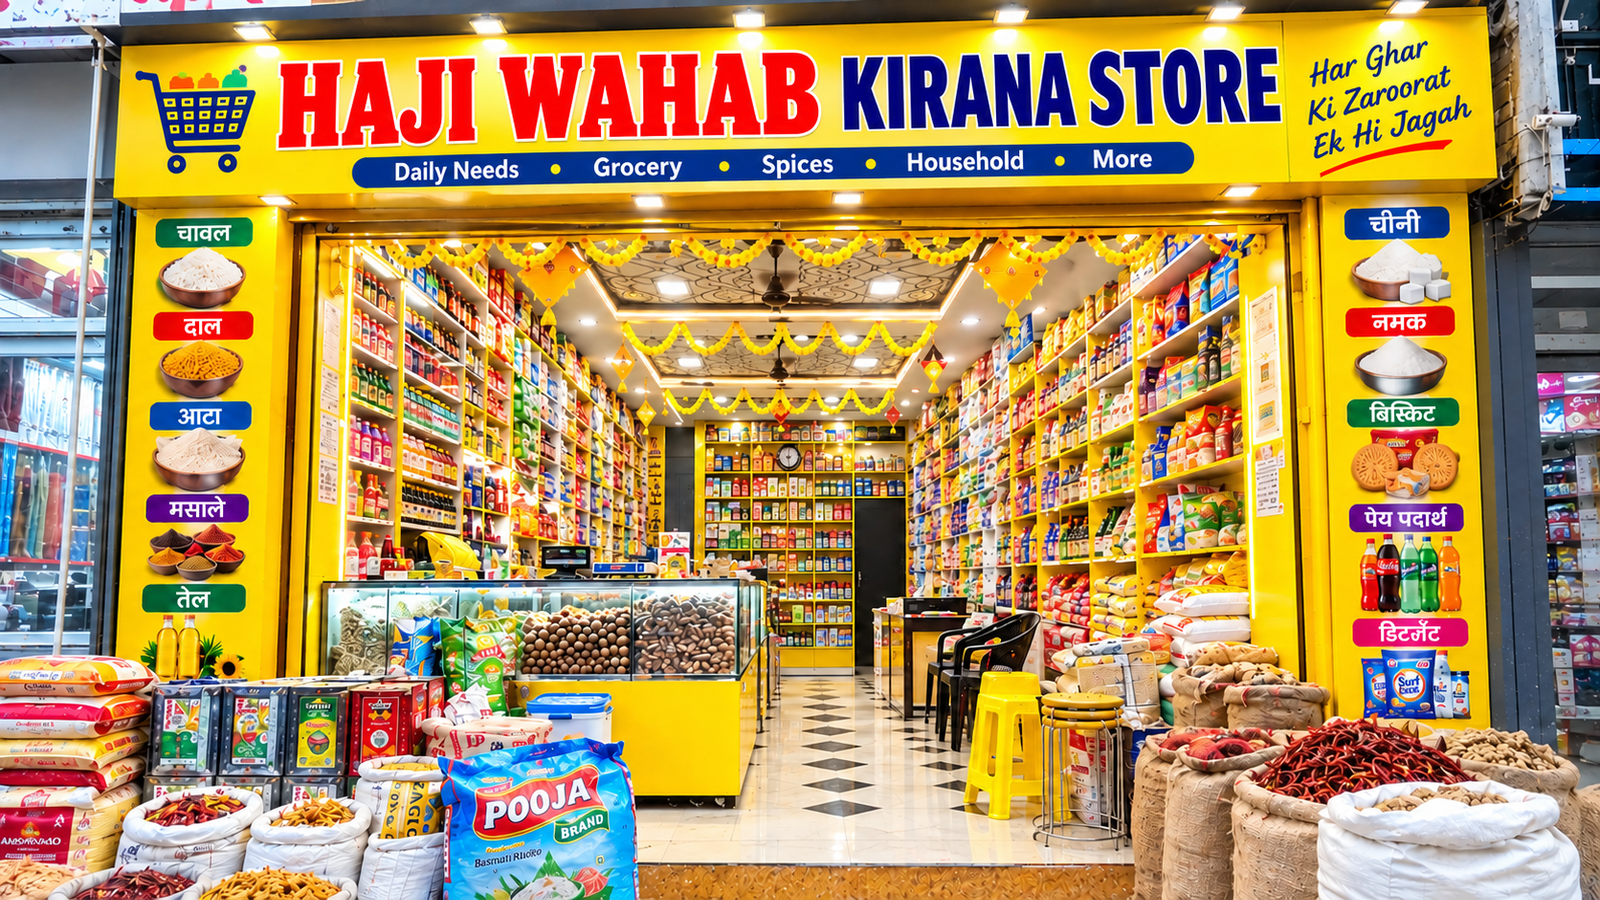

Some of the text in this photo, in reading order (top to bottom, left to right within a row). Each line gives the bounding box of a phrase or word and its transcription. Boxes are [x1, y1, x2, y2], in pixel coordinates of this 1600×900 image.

[1309, 40, 1428, 88] Har Ghar
[278, 48, 1281, 148] HAJI WAHAB KIRANA STORE
[1308, 65, 1451, 126] Ki Zaroorat
[1313, 94, 1472, 159] Ek Hi Jagah
[593, 156, 683, 181] Grocery
[762, 153, 834, 179] Spices
[907, 149, 1024, 172] Household
[1093, 149, 1153, 169] More
[395, 158, 520, 186] Daily Needs
[176, 224, 232, 242] चावल
[1368, 209, 1421, 234] चीनी
[183, 318, 223, 337] दाल
[1371, 313, 1427, 331] नमक
[178, 408, 222, 425] आटा
[1369, 401, 1436, 423] बिस्किट
[169, 495, 226, 518] मसाले
[1364, 506, 1448, 528] पेय पदार्थ
[176, 586, 211, 609] तेल
[483, 777, 592, 830] POOJA
[560, 813, 604, 840] BRAND
